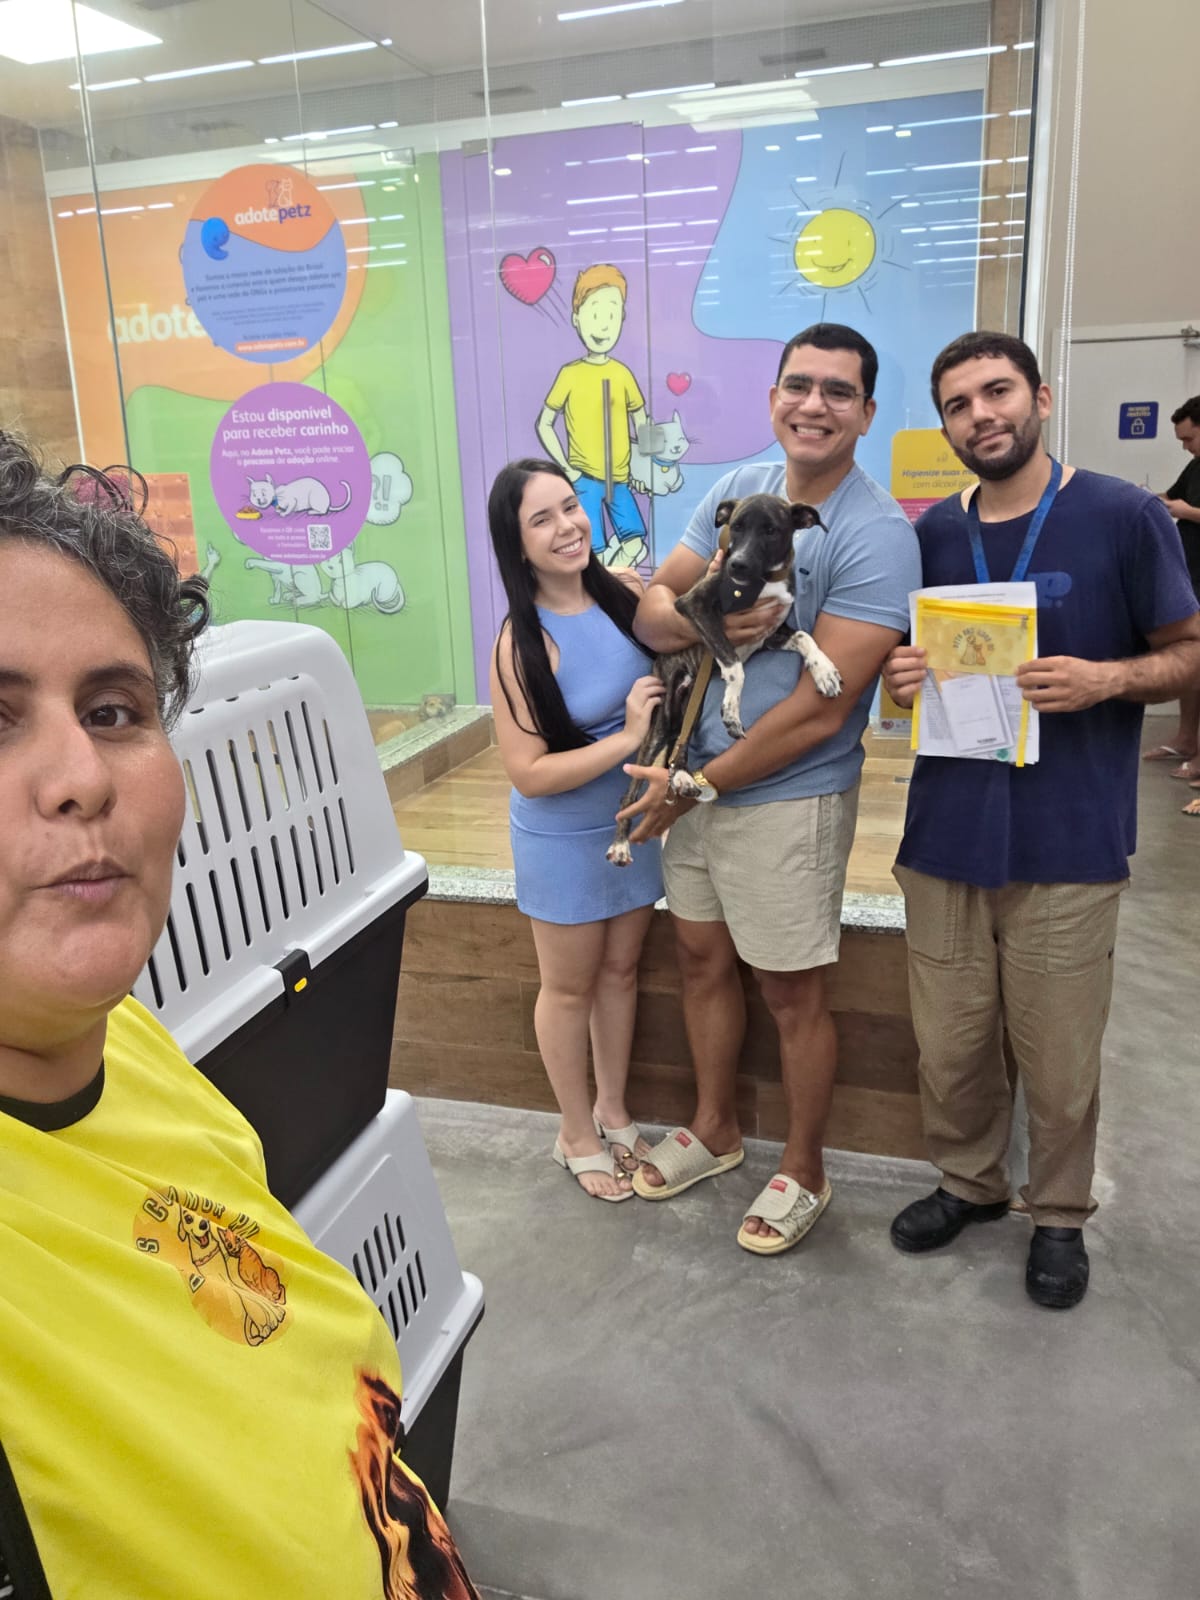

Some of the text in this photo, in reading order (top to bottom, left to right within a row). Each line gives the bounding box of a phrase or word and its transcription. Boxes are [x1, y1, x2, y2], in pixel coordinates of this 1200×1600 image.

[235, 204, 311, 224] adotepetz
[232, 406, 332, 423] Estou disponível
[223, 422, 348, 442] para receber carinho
[251, 448, 273, 456] Adote
[287, 456, 314, 465] adoção
[902, 469, 940, 479] Higienize
